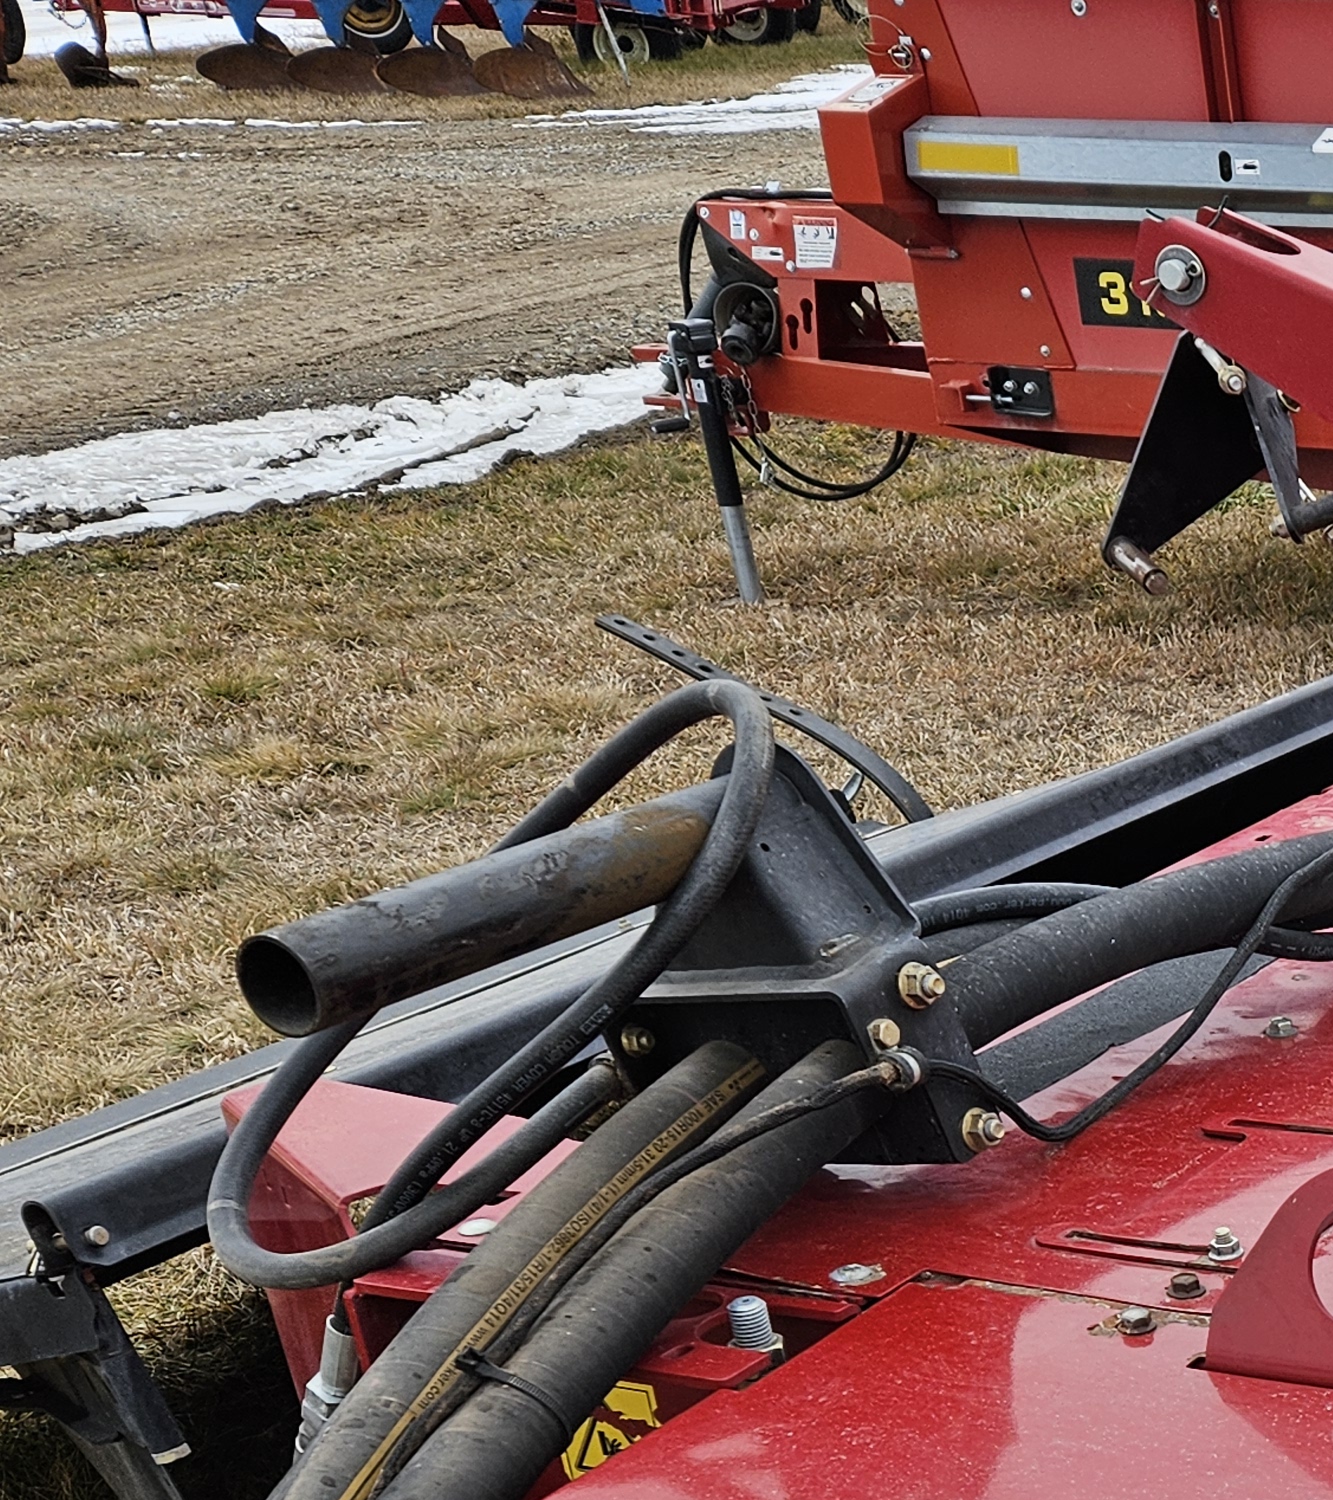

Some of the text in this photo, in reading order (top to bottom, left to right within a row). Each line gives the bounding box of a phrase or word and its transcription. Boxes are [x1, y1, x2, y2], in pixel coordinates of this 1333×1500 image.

[512, 1060, 547, 1092] COVER
[701, 1088, 724, 1112] SAE
[658, 1106, 702, 1150] 100R15-20
